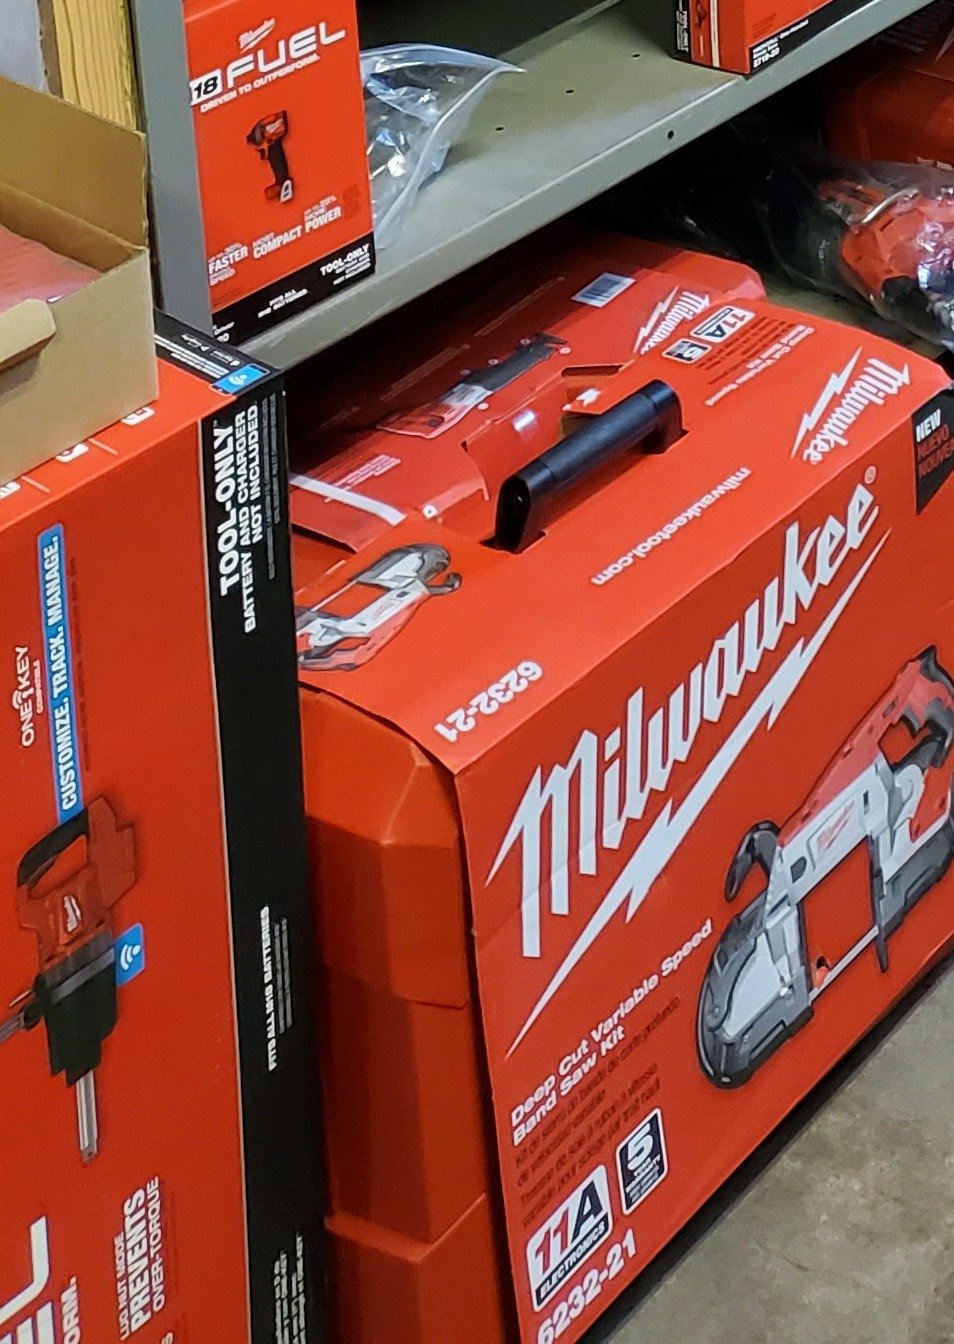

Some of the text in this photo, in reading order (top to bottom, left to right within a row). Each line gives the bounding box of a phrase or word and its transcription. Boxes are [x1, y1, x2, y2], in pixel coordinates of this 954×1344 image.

[199, 54, 321, 114] DRIVEN TO OUTPERFORM.
[226, 20, 346, 90] FUEL
[208, 245, 249, 275] FASTER
[252, 225, 303, 259] COMPACT
[304, 206, 342, 234] POWER
[320, 243, 370, 276] TOOL-ONLY
[803, 358, 911, 465] Milwaukee
[915, 408, 942, 443] NEW
[213, 424, 241, 598] TOOL-ONLY
[234, 410, 257, 634] BATTERY AND CHARGER
[246, 404, 263, 545] NOT INCLUDED
[590, 465, 752, 586] milwaukeetool.com
[15, 646, 35, 747] ONE KEY
[41, 534, 78, 811] CUSTOMIZE. TRACK. MANAGE.
[432, 659, 544, 744] 6232-21
[485, 472, 880, 958] Milwaukee
[510, 919, 714, 1128] Deep Cut Variable Speed
[513, 1022, 626, 1147] Band Saw Kit
[627, 1122, 655, 1172] 5
[123, 1187, 152, 1334] PREVENTS
[146, 1175, 167, 1313] OVER-TORQUE
[534, 1180, 610, 1272] 11A
[536, 1221, 607, 1300] ELECTRONICS
[534, 1230, 638, 1344] 6232-21
